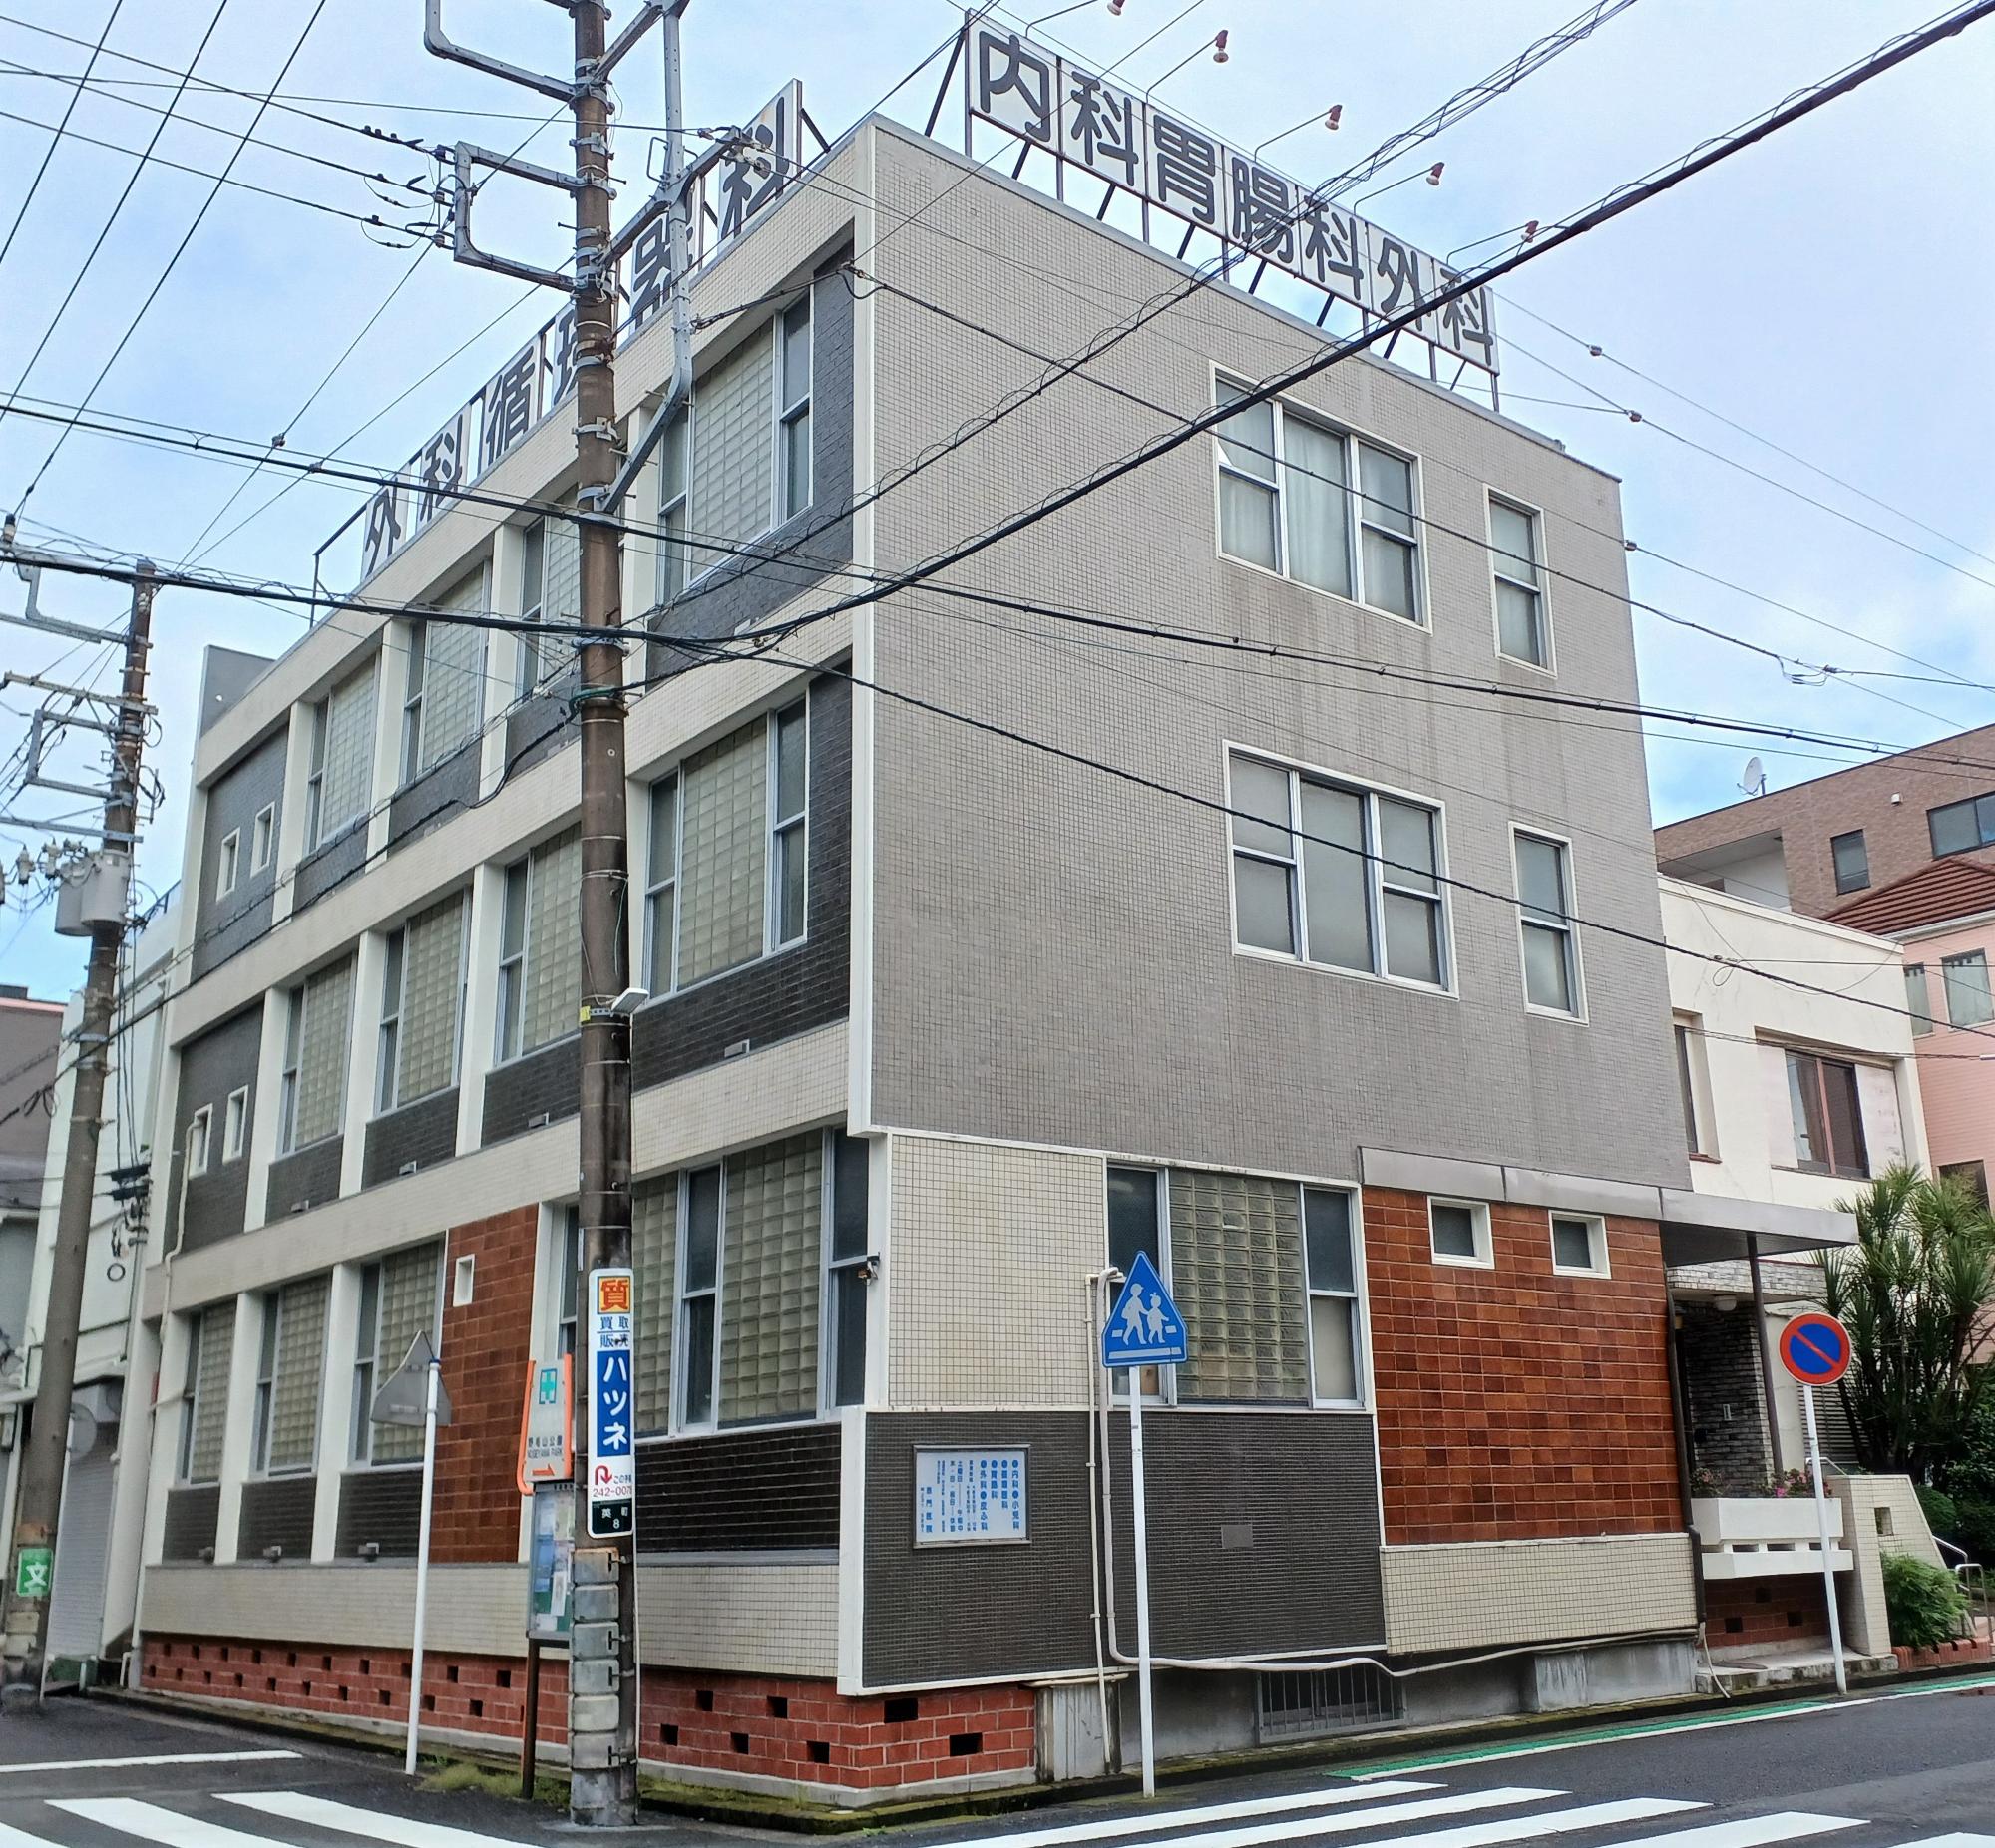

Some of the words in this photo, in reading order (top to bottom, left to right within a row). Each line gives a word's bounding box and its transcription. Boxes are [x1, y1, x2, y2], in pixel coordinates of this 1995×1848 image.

[978, 30, 1494, 367] 内科胃腸科外科
[600, 1279, 629, 1311] 質
[600, 1316, 629, 1330] 買取
[602, 1356, 628, 1451] ハツネ
[612, 1518, 620, 1530] 8
